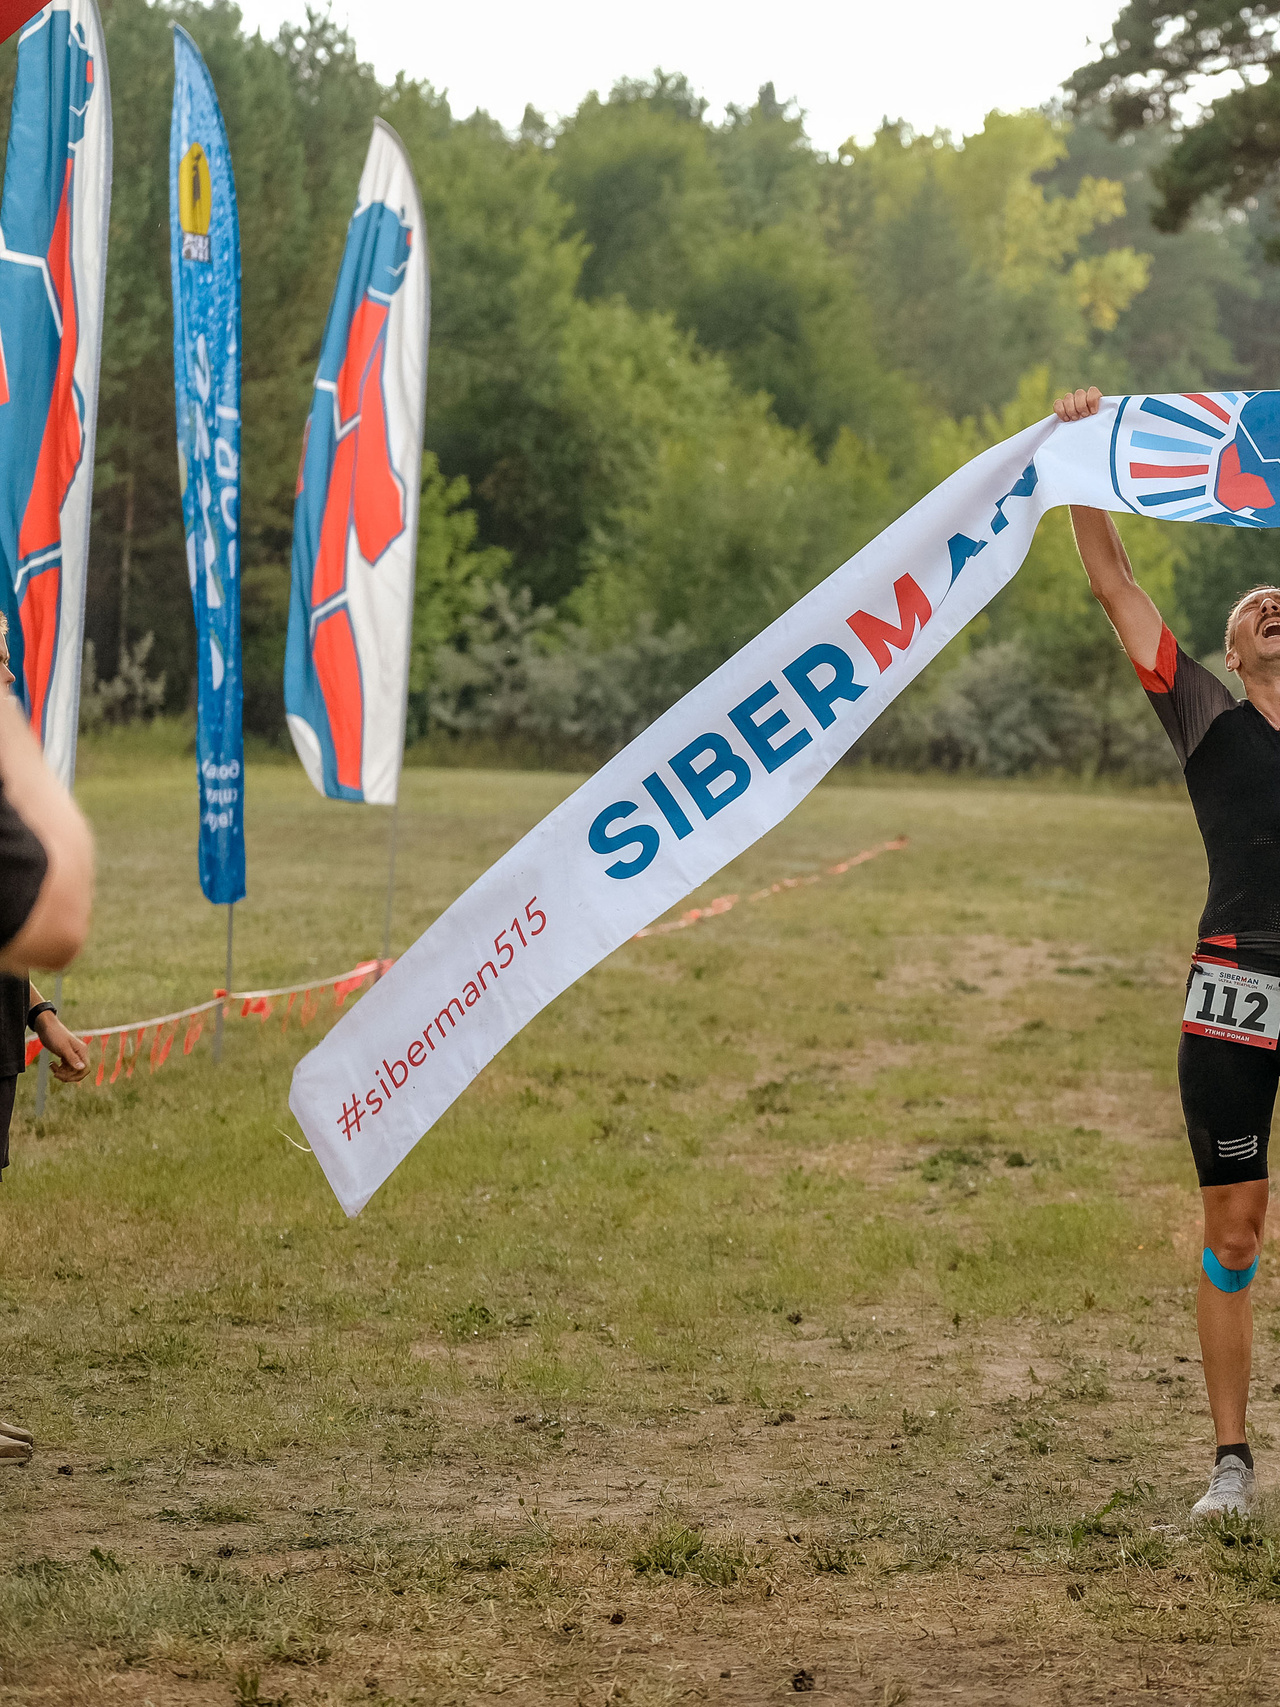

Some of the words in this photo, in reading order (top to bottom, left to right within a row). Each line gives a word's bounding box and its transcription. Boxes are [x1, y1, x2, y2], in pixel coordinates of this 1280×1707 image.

[1219, 971, 1259, 985] SIBERMAN
[336, 896, 548, 1141] #siberman515
[1195, 981, 1269, 1033] 112
[1226, 1032, 1250, 1042] РОМАН
